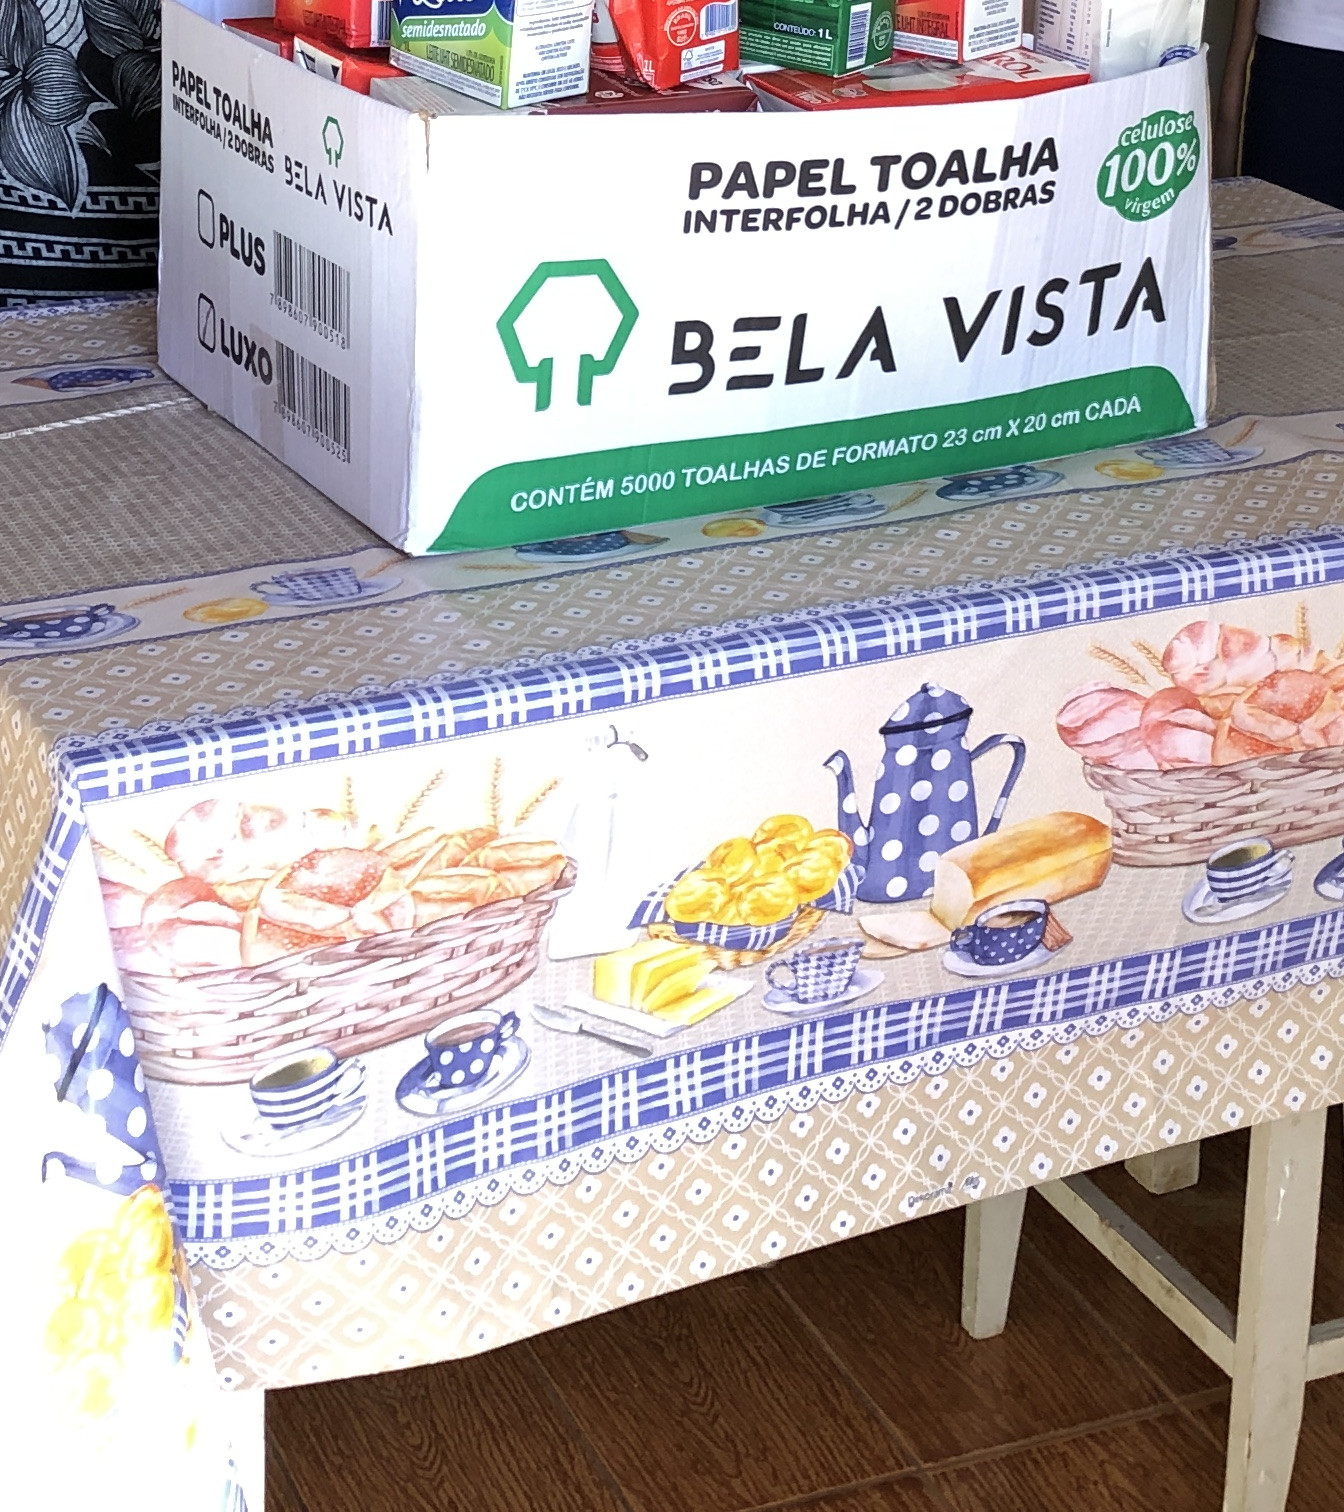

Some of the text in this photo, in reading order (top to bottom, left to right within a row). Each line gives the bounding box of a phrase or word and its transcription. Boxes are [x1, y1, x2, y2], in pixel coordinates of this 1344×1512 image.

[401, 18, 487, 39] semidesnatado
[773, 21, 816, 37] CONTEÚDO:
[451, 51, 495, 82] SEMIDESNATADO
[171, 59, 274, 149] PAPEL TOALHA
[172, 92, 222, 143] INTERFOLHA
[227, 129, 234, 150] 2
[234, 133, 275, 174] DOBRAS
[1120, 114, 1194, 147] celulose
[284, 154, 394, 237] BELA VISTA
[688, 136, 1060, 201] PAPEL TOALHA
[1104, 137, 1198, 199] 100%
[683, 179, 1057, 235] INTERFOLHA / 2 DOBRAS
[1124, 188, 1175, 218] virgem
[219, 211, 267, 276] PLUS
[219, 316, 274, 386] LUXO
[668, 256, 1167, 396] BELA VISTA
[509, 394, 1143, 513] CONTÉM 5000 TOALHAS DE FORMATO 23 cm X 20 cm CADA
